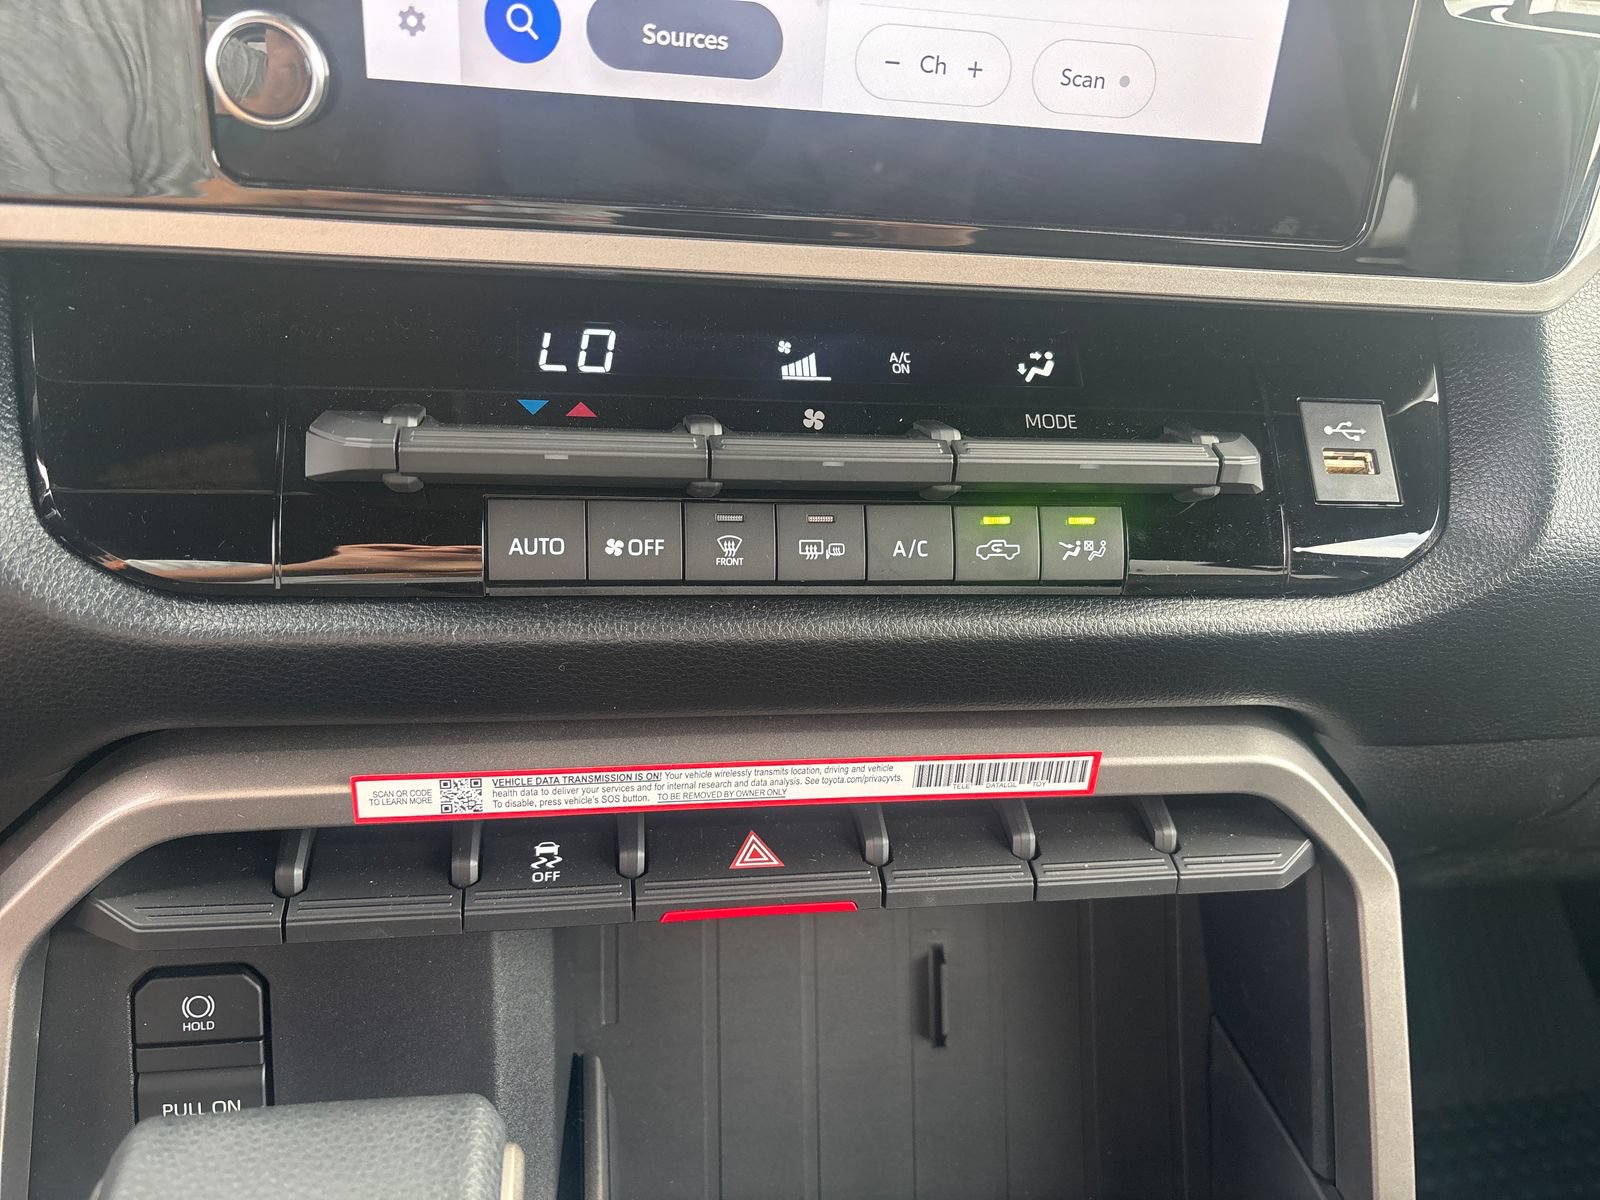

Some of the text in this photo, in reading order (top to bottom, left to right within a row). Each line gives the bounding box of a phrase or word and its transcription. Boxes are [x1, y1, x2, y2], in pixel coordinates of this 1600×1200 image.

[642, 22, 729, 51] Sources
[919, 55, 947, 75] Ch
[1060, 67, 1106, 90] Scan
[538, 328, 617, 374] LO
[889, 351, 911, 364] A/C
[892, 363, 911, 375] ON
[1025, 413, 1078, 430] MODE
[508, 537, 565, 556] AUTO
[627, 538, 665, 556] OFF
[892, 538, 929, 559] A/C
[715, 557, 744, 566] FRONT
[492, 763, 894, 787] VEHICLE DATA TRANSMISSION IS ON! Your vehicle wirelessly transmits location, driving and vehicle
[372, 788, 432, 799] SCAN QR CODE
[492, 788, 518, 798] health
[520, 787, 538, 797] data
[541, 787, 549, 796] to
[552, 786, 579, 796] deliver
[581, 785, 599, 795] your
[602, 784, 634, 793] services
[637, 783, 652, 791] and
[654, 783, 665, 791] for
[667, 781, 696, 790] internal
[698, 780, 732, 789] research
[734, 779, 749, 788] and
[751, 778, 767, 787] data
[770, 777, 802, 788] analysis.
[805, 776, 819, 785] See
[657, 788, 787, 801] TO BE REMOVED BY OWNER ONLY
[369, 796, 432, 806] TO LEARN MORE
[492, 794, 650, 809] To disable, press vehicle's SOS button.
[531, 871, 561, 883] OFF
[182, 1020, 215, 1032] HOLD
[162, 1099, 241, 1117] PULL ON
